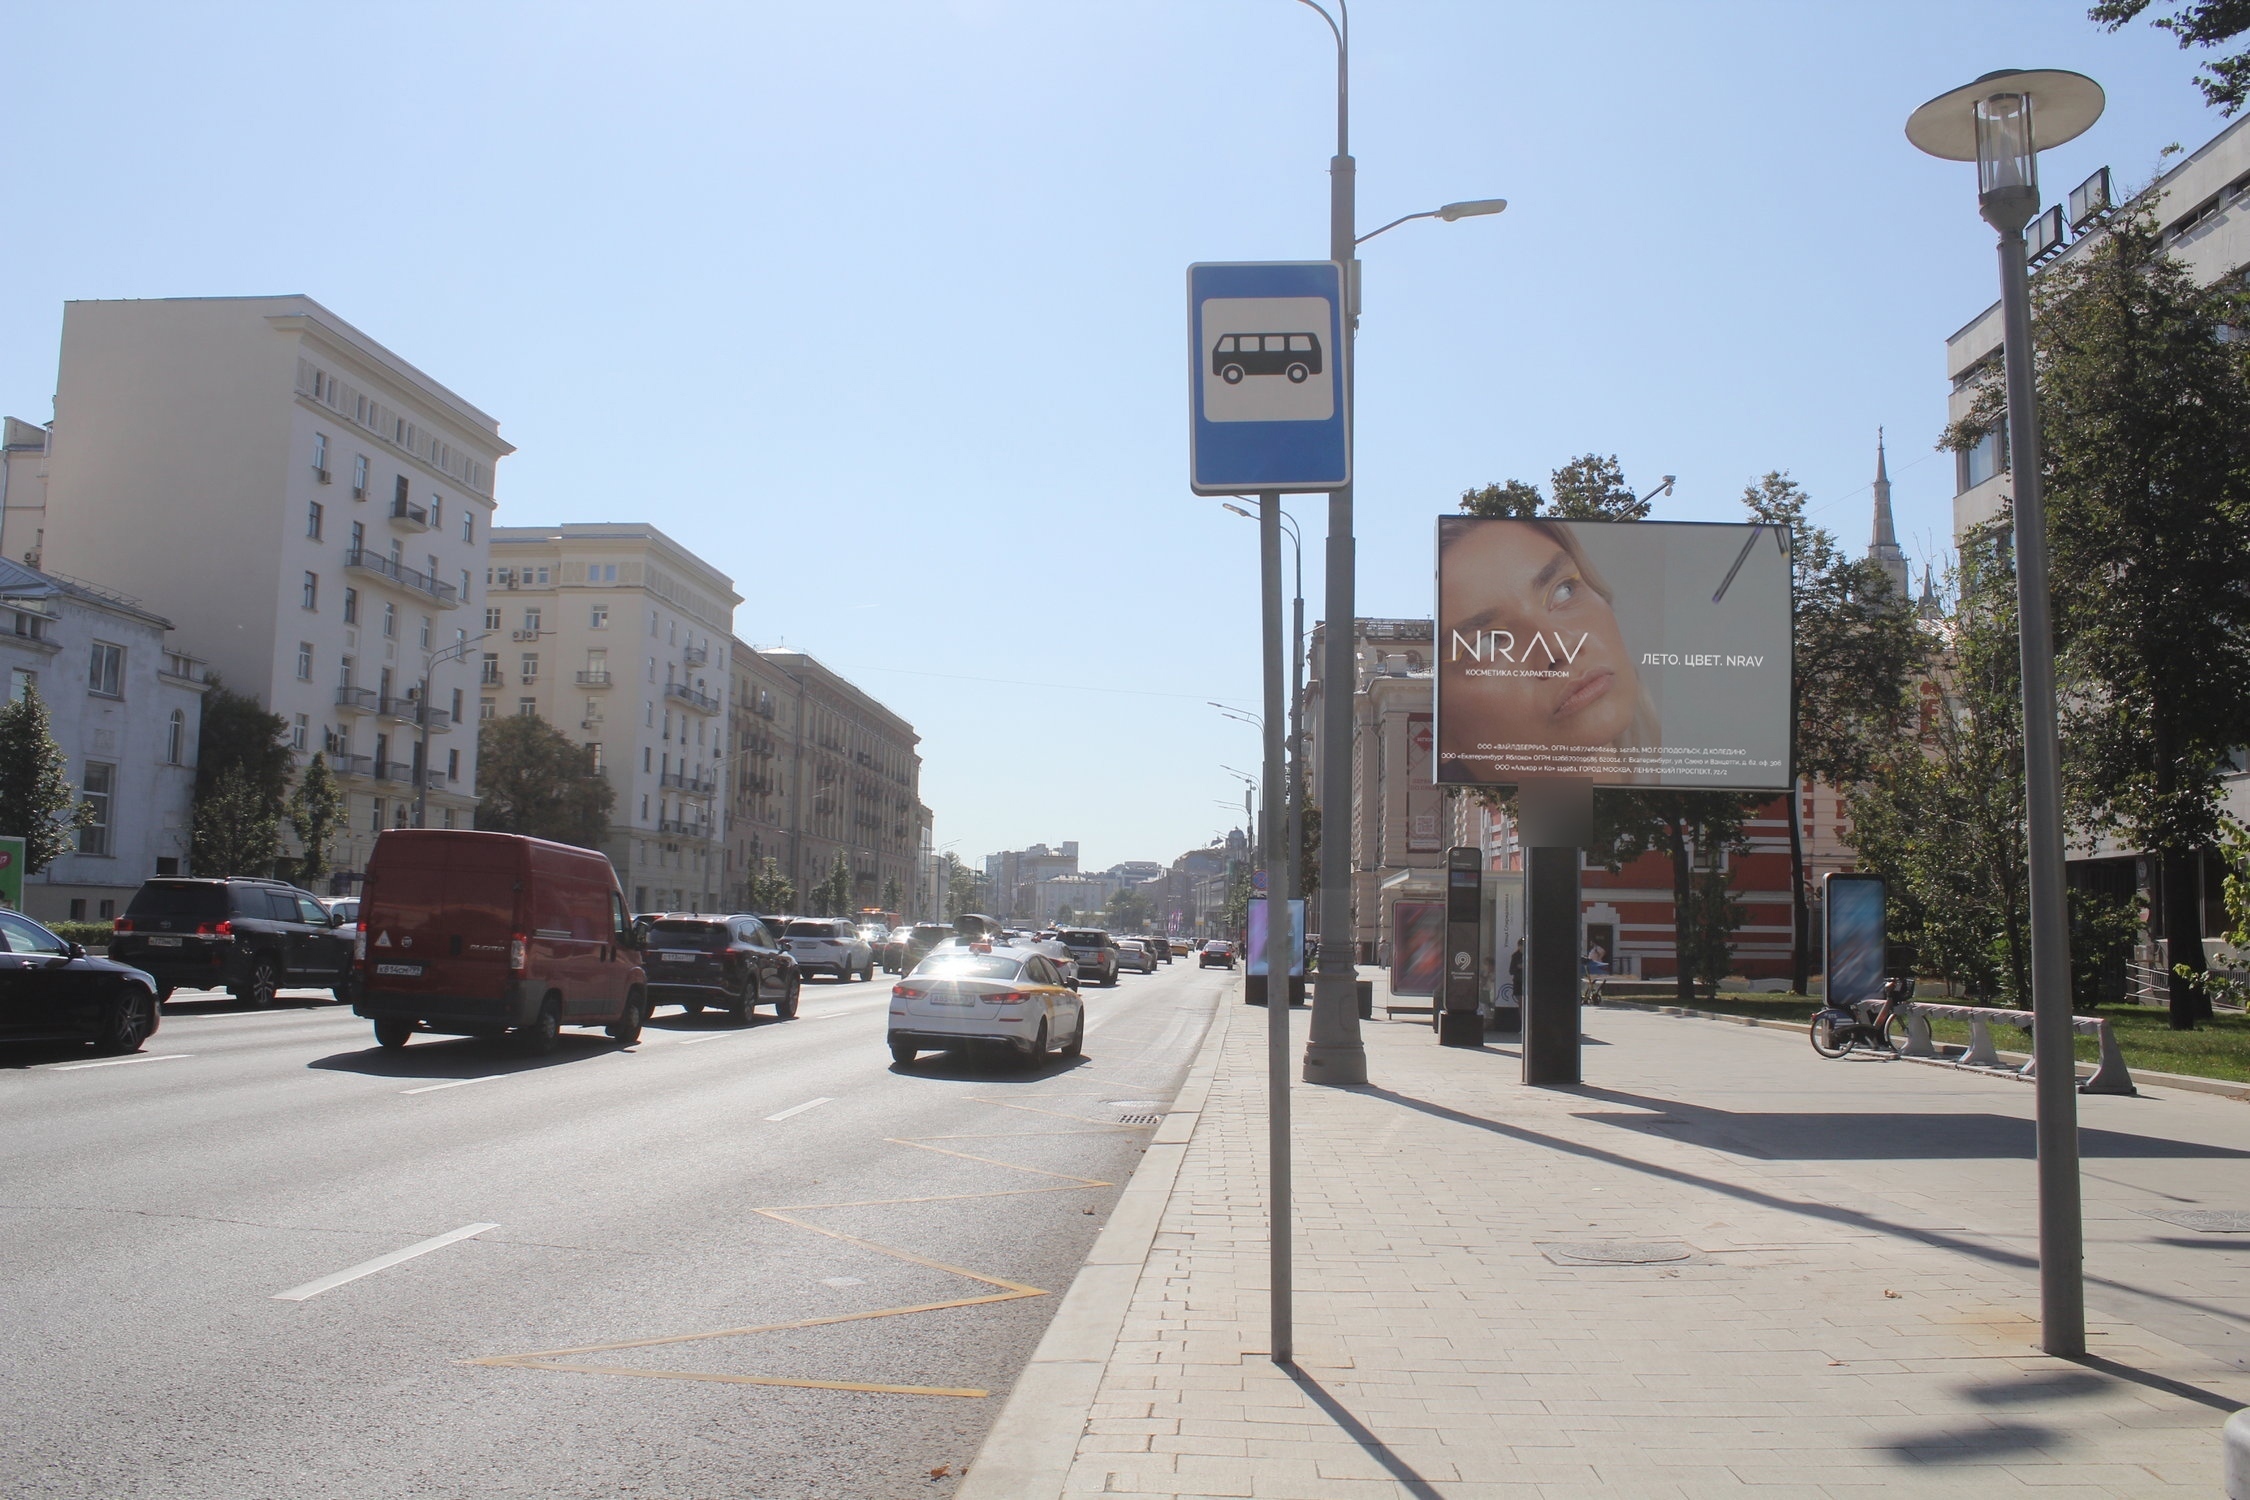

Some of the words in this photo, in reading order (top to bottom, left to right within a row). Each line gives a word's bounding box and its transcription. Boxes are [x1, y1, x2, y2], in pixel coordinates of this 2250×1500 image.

[1452, 629, 1588, 664] NRAV
[1641, 653, 1681, 665] ЛЕТО.
[1684, 654, 1723, 667] ЦВЕТ.
[1726, 655, 1764, 667] NRAV
[1465, 668, 1512, 677] КОСМЕТИКА
[1513, 669, 1519, 677] С
[1519, 669, 1569, 678] ХАРАКТЕРОМ
[1551, 744, 1569, 752] ОГРН
[1495, 763, 1510, 771] ООО
